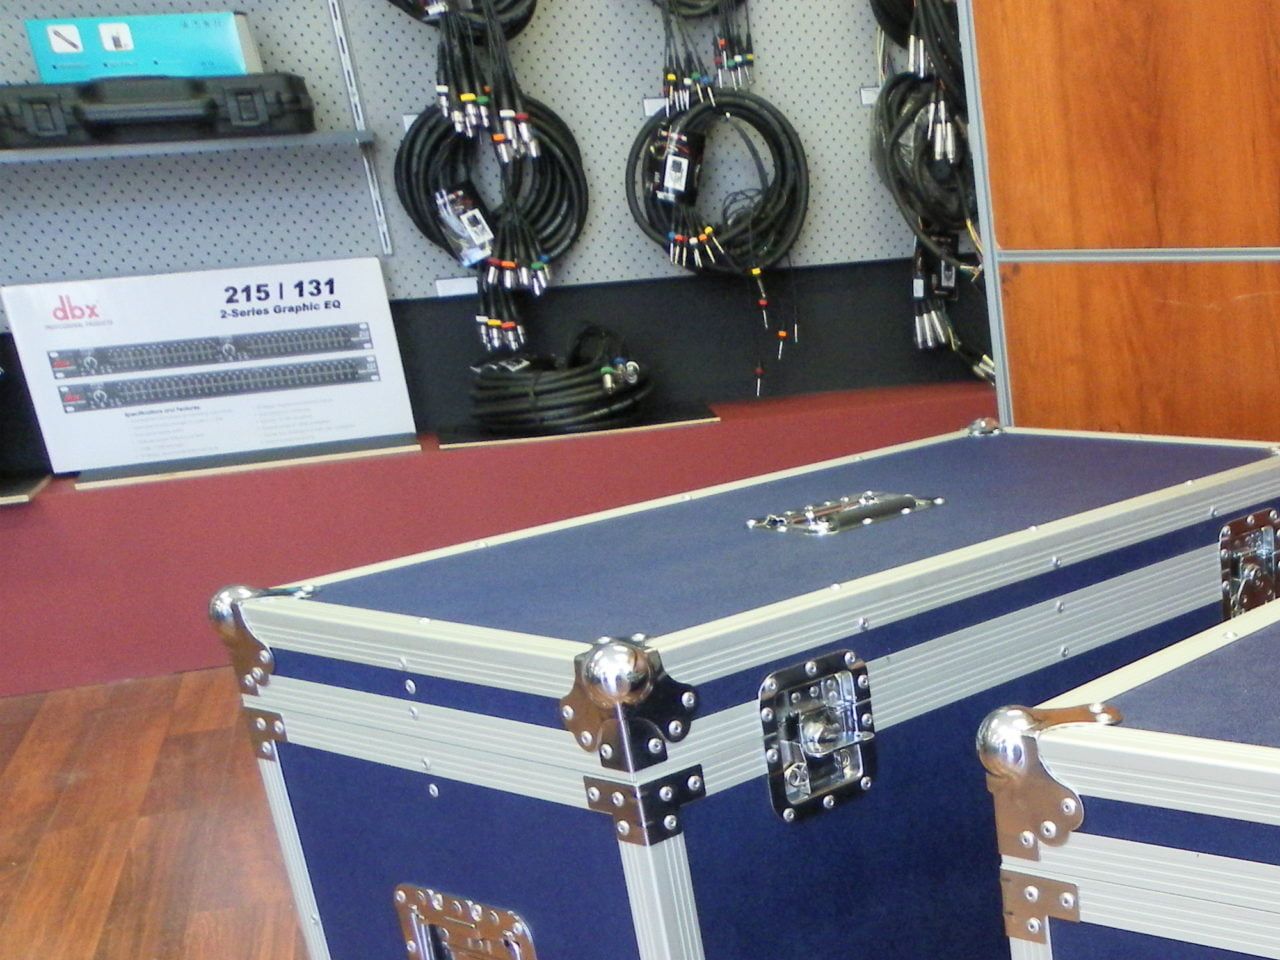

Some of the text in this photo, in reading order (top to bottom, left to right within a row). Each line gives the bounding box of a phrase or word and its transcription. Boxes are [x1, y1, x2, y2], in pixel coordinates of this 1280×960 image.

[224, 283, 270, 304] 215
[293, 278, 335, 297] 131
[53, 295, 99, 320] dbx
[220, 299, 341, 319] 2-Series Graphic EQ
